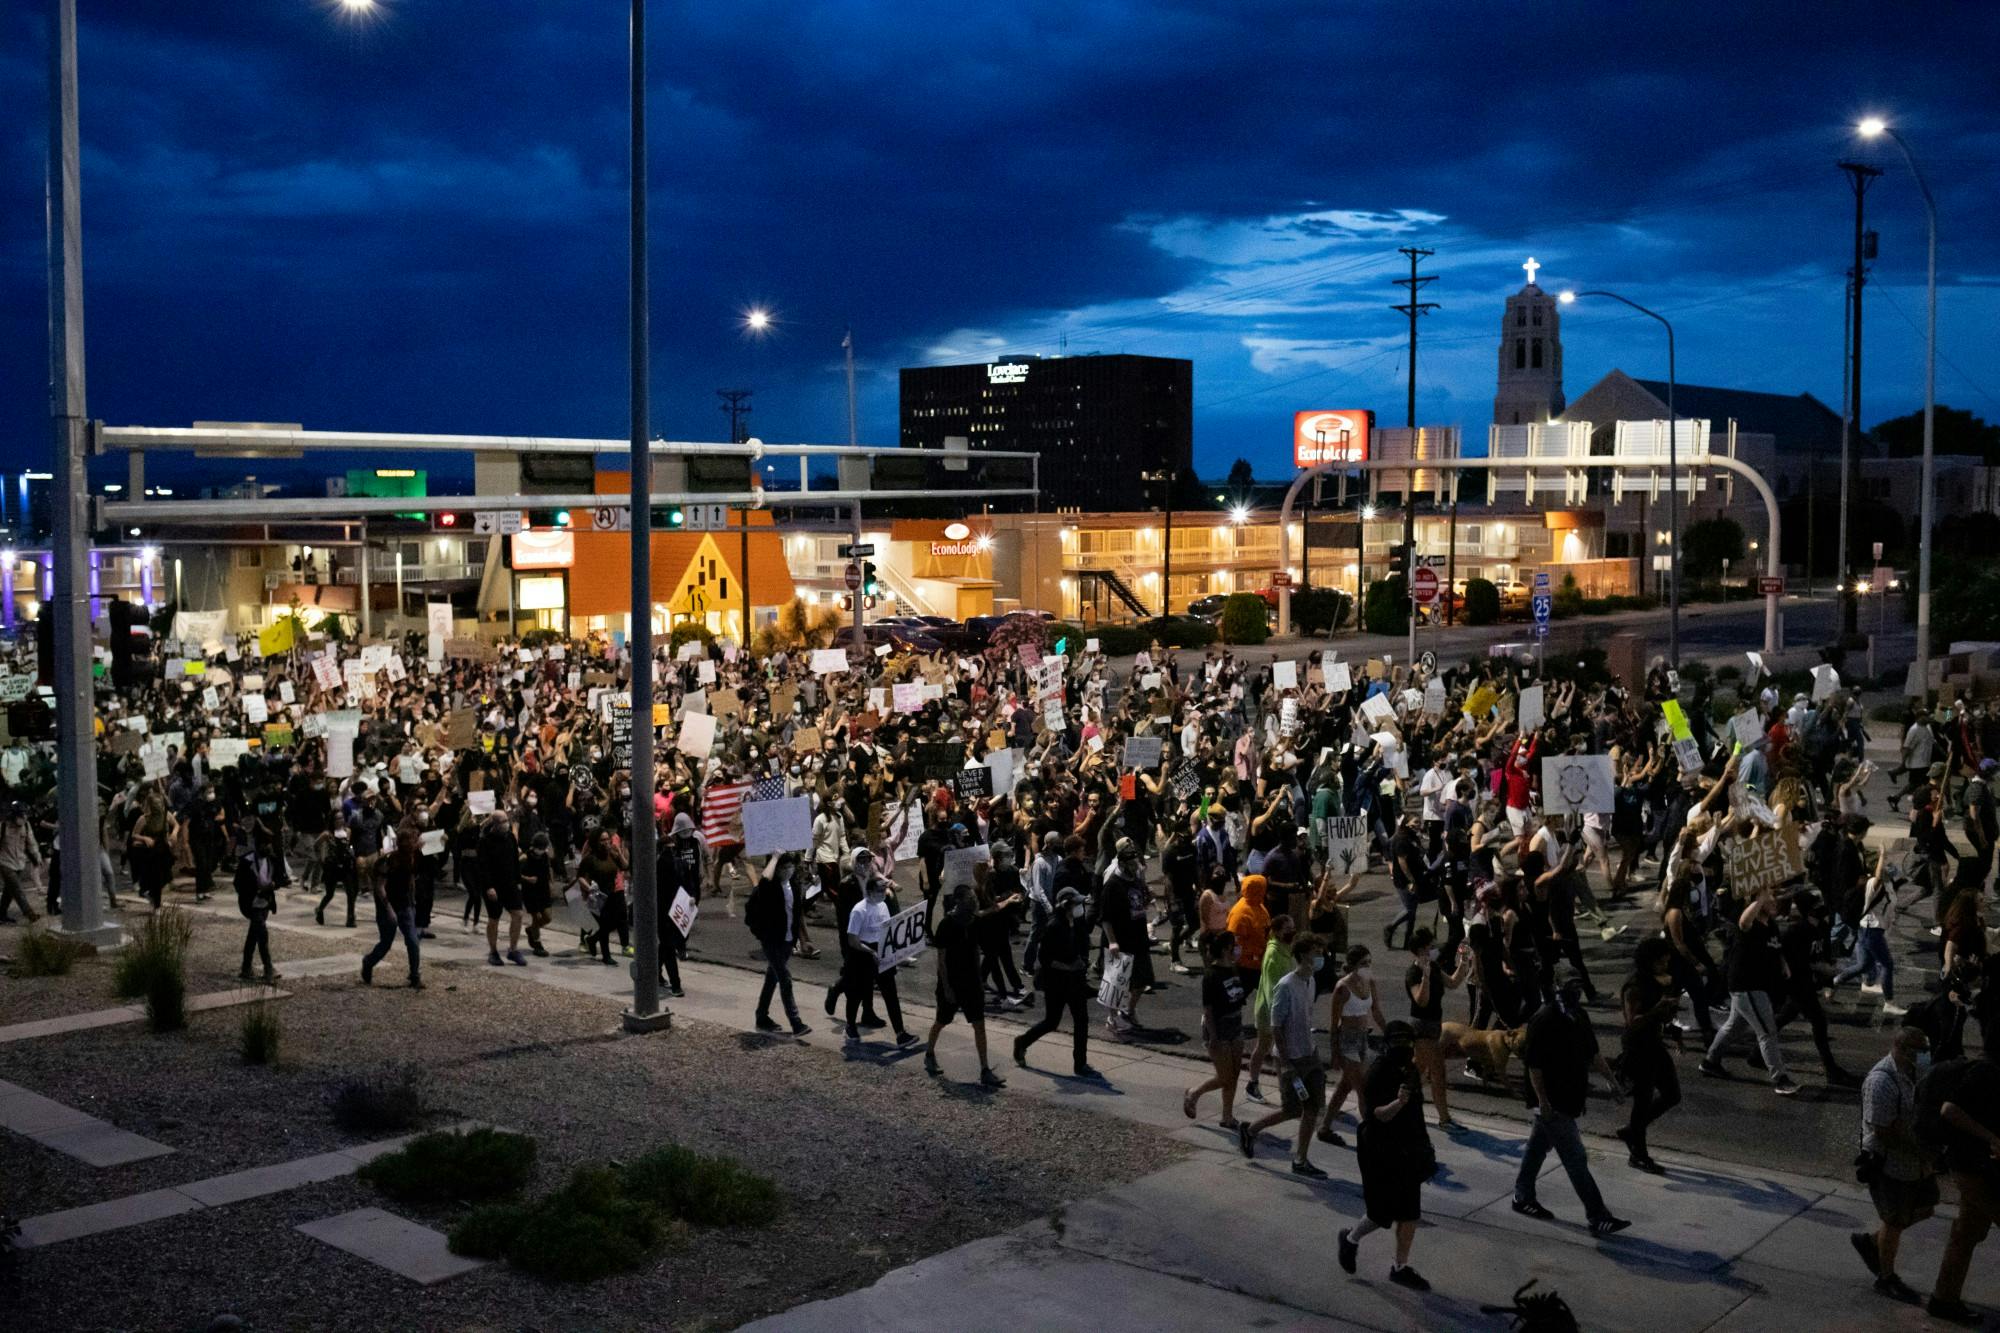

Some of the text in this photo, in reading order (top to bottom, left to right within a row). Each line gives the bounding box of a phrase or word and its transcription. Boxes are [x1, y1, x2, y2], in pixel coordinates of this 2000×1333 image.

[987, 362, 1029, 377] Lovelace
[1536, 599, 1549, 617] 25
[957, 769, 984, 781] NEVER
[960, 788, 985, 799] NAMES
[1329, 816, 1367, 840] HANDS
[1733, 831, 1787, 864] BLACK
[1734, 848, 1788, 877] LIVES
[1735, 862, 1796, 897] MATTER
[673, 904, 684, 923] NO
[680, 914, 690, 930] NO
[881, 911, 925, 959] ACAB
